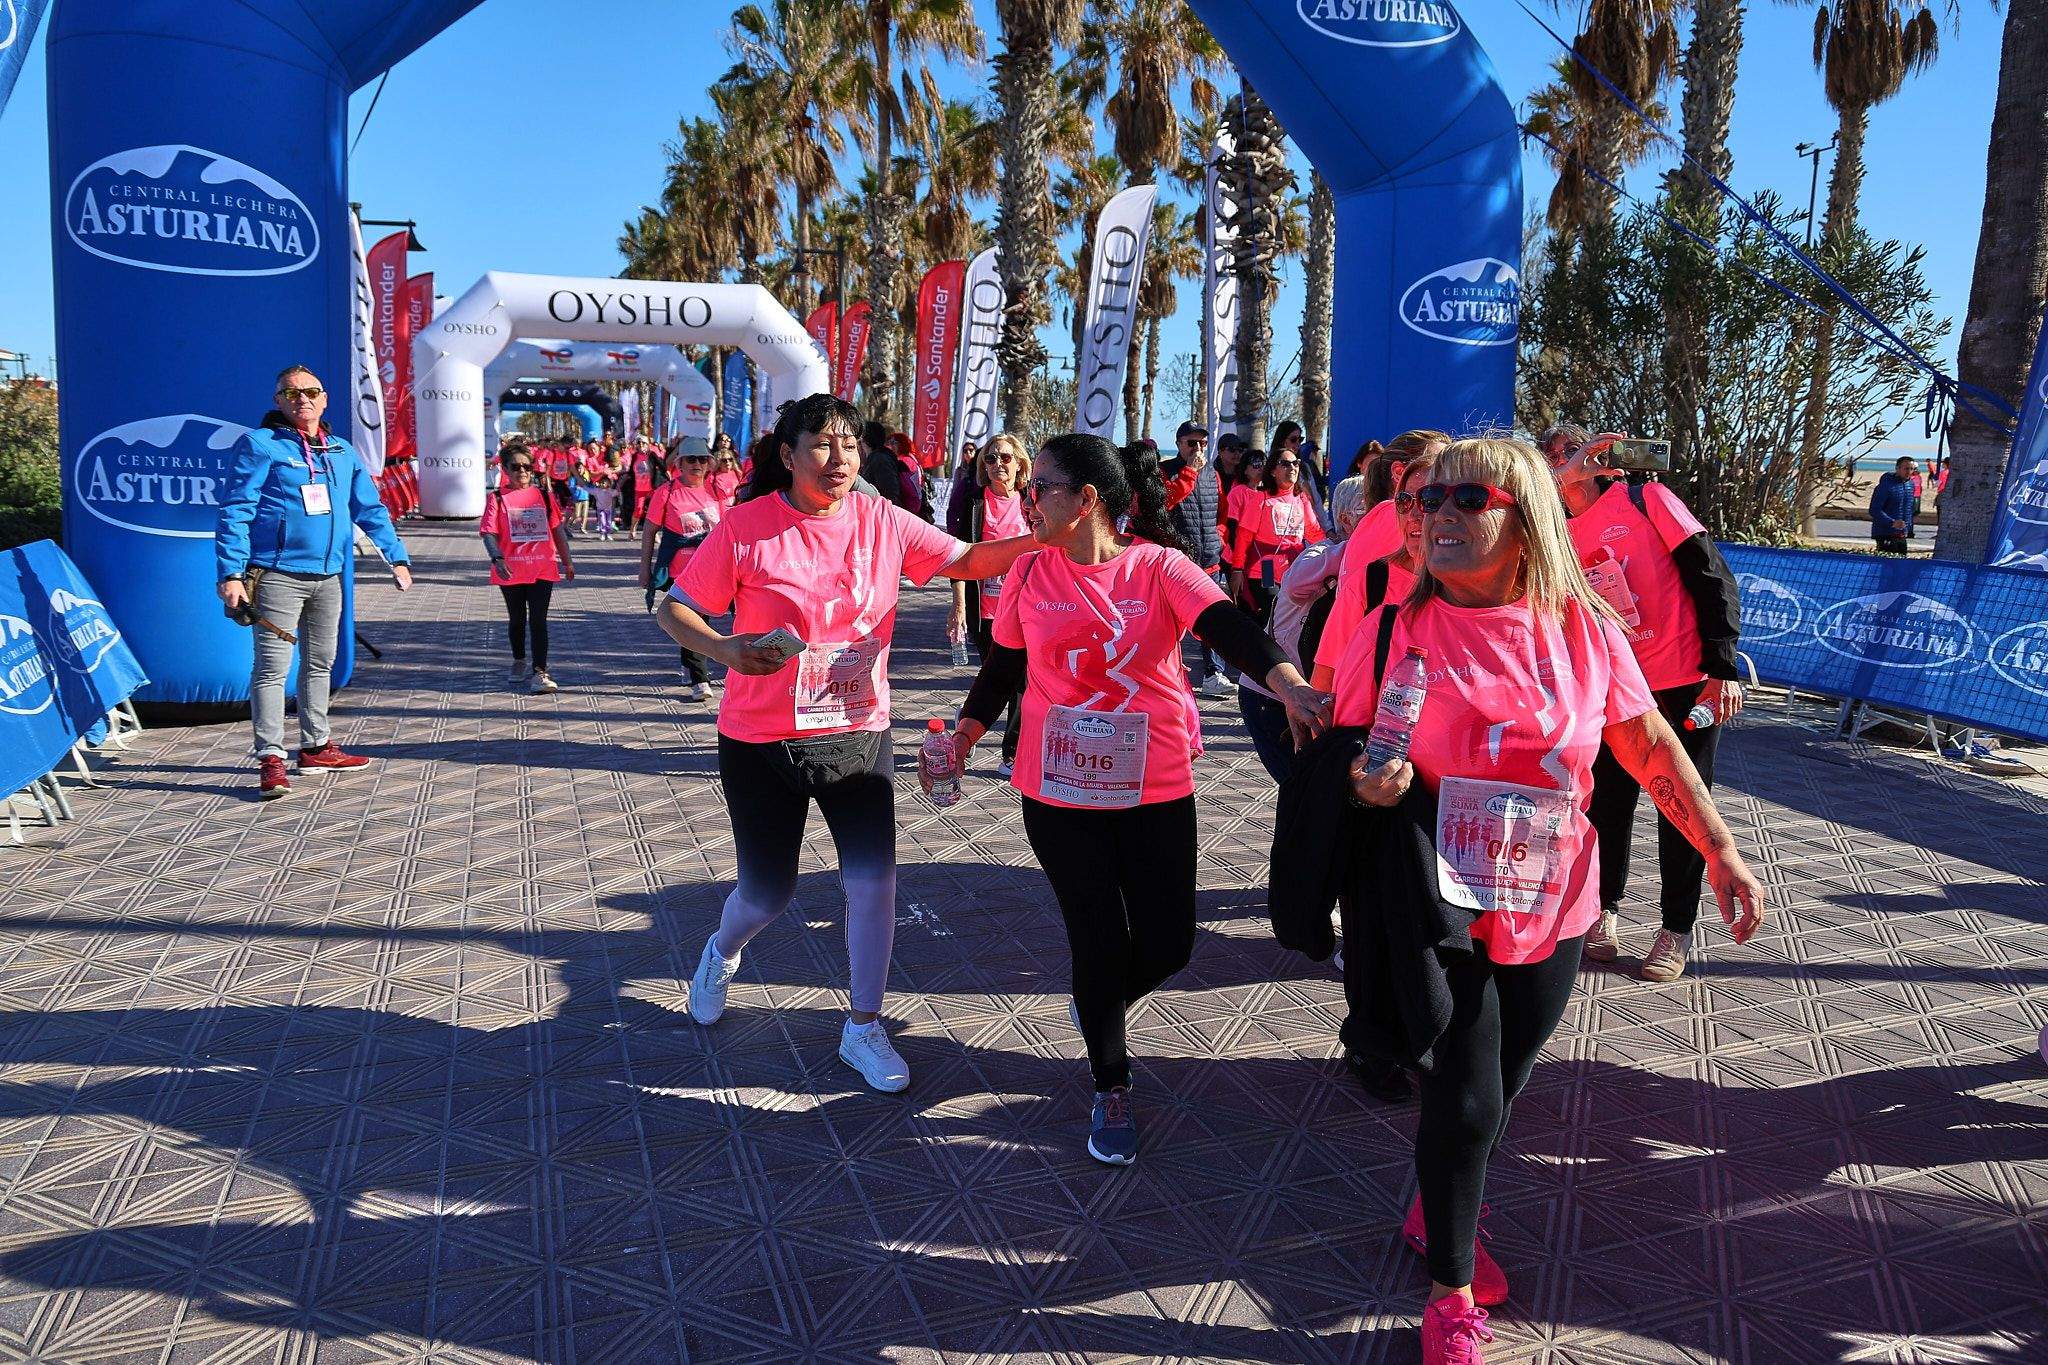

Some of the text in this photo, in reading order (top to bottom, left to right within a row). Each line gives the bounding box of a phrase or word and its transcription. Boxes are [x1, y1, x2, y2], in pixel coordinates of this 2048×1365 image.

[1310, 0, 1455, 28] ASTURIANA
[109, 184, 298, 220] CENTRAL LECHERA
[77, 187, 306, 257] ASTURIANA
[1443, 287, 1495, 297] CENTRAL
[379, 262, 395, 357] Santander
[548, 290, 713, 328] OYSHO
[444, 322, 497, 336] OYSHO
[1084, 225, 1139, 429] OYSHO
[757, 333, 803, 345] OYSHO
[841, 320, 862, 388] Santander
[963, 279, 1001, 440] OYSHO
[923, 285, 948, 455] Sports Santander
[422, 389, 472, 401] OYSHO
[510, 387, 581, 398] VOLVO
[117, 455, 207, 470] CENTRAL
[423, 456, 472, 468] OYSHO
[87, 456, 226, 506] ASTUR
[1036, 601, 1077, 612] OYSHO
[1823, 611, 1957, 657] ASTURIANA
[1426, 665, 1481, 683] OYSHO
[829, 680, 859, 695] 016
[1074, 723, 1113, 735] ASTURIANA
[1074, 753, 1114, 771] 016
[1051, 785, 1080, 799] OYSHO
[1451, 802, 1479, 812] SUMA
[1490, 800, 1533, 815] ASTRIANA
[1487, 840, 1528, 862] 016
[1454, 874, 1484, 886] CARRERA
[1518, 881, 1545, 891] VALENCIA
[1507, 894, 1544, 907] Santander
